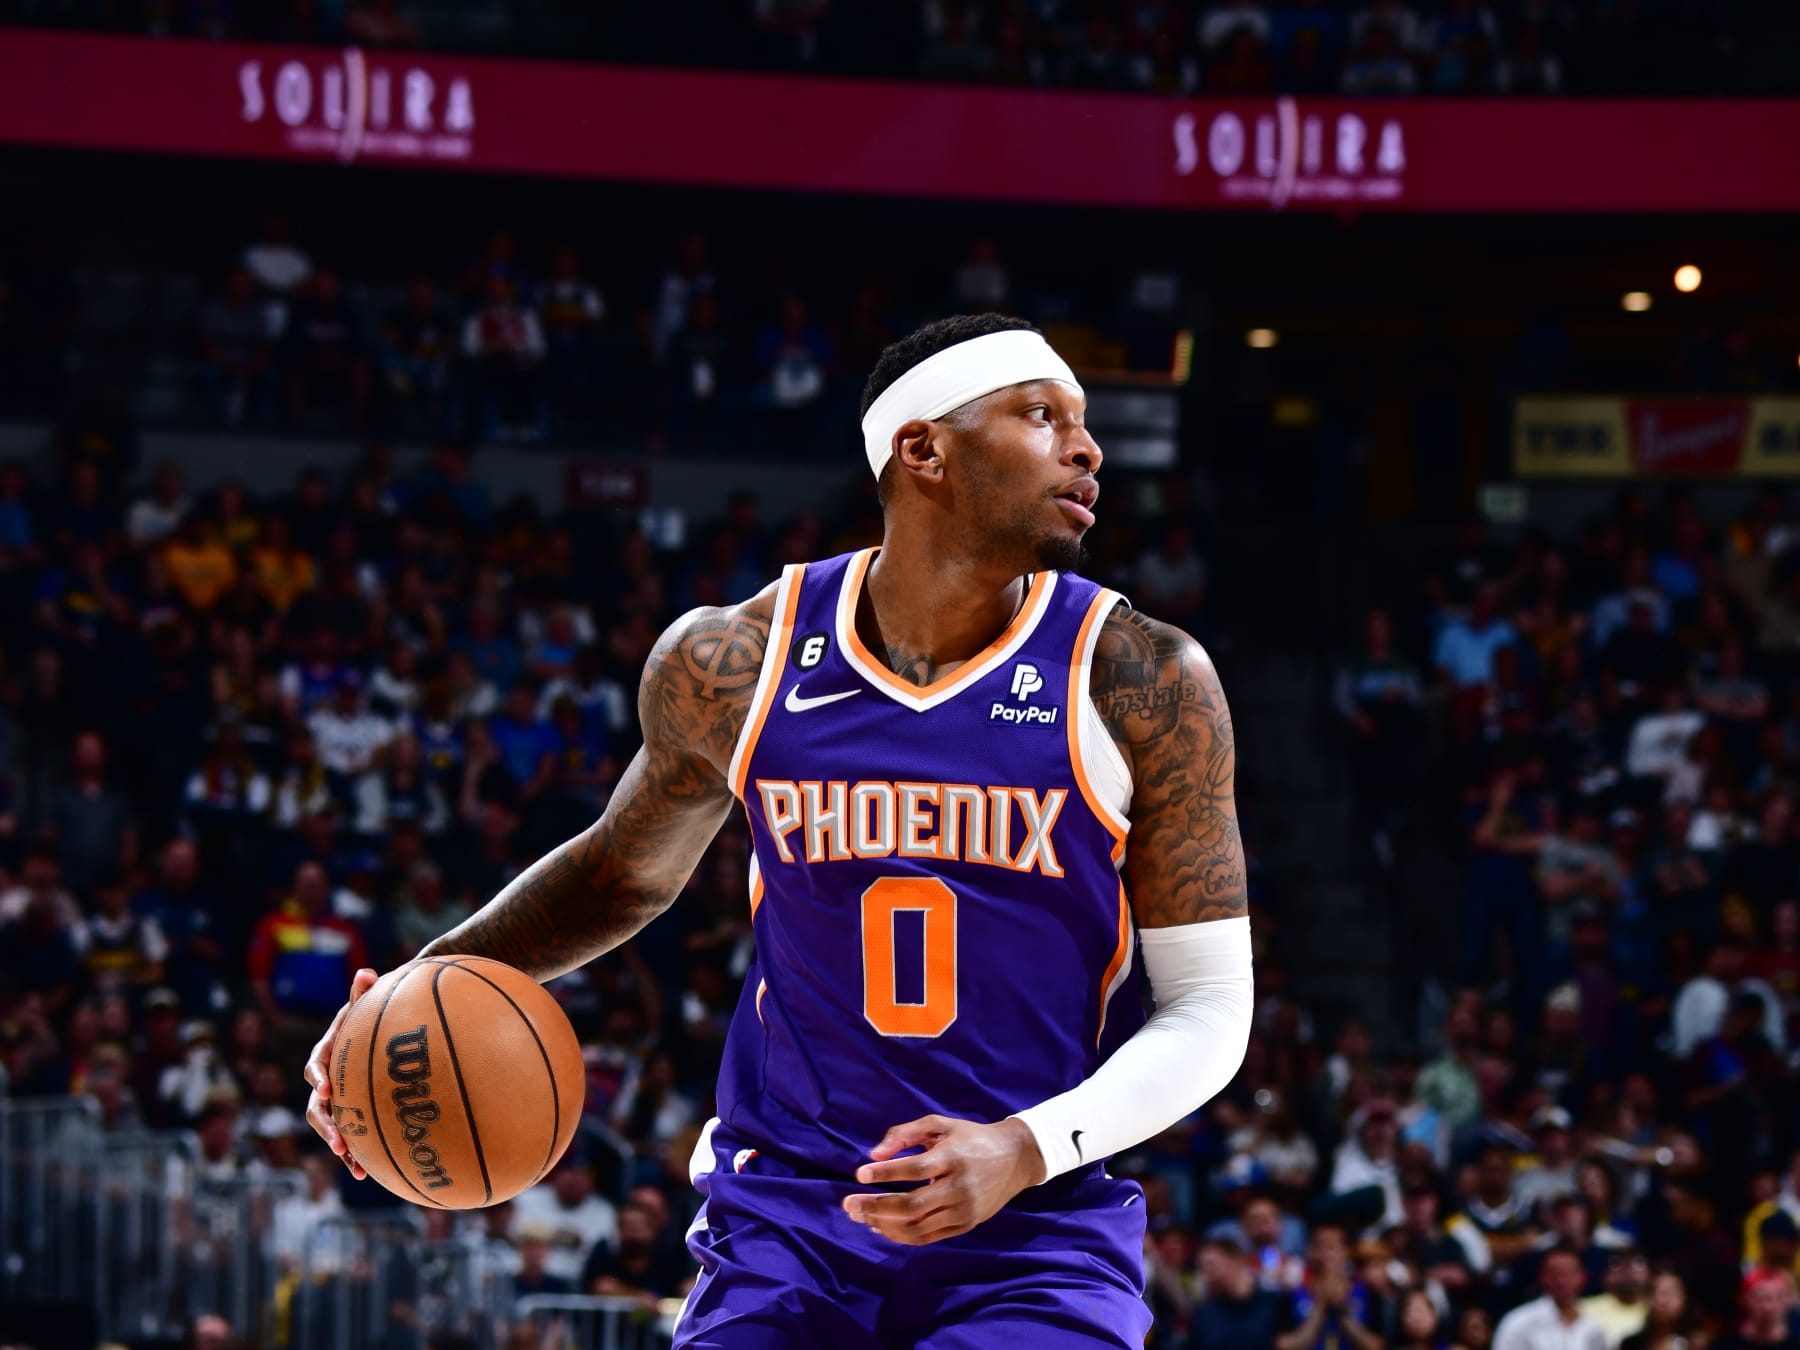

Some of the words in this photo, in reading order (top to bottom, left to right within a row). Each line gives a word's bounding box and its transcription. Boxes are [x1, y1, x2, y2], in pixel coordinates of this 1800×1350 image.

[800, 635, 826, 668] 6
[990, 703, 1058, 724] PayPal
[756, 779, 1068, 878] PHOENIX
[861, 876, 957, 1038] 0
[386, 1024, 453, 1191] Wilson
